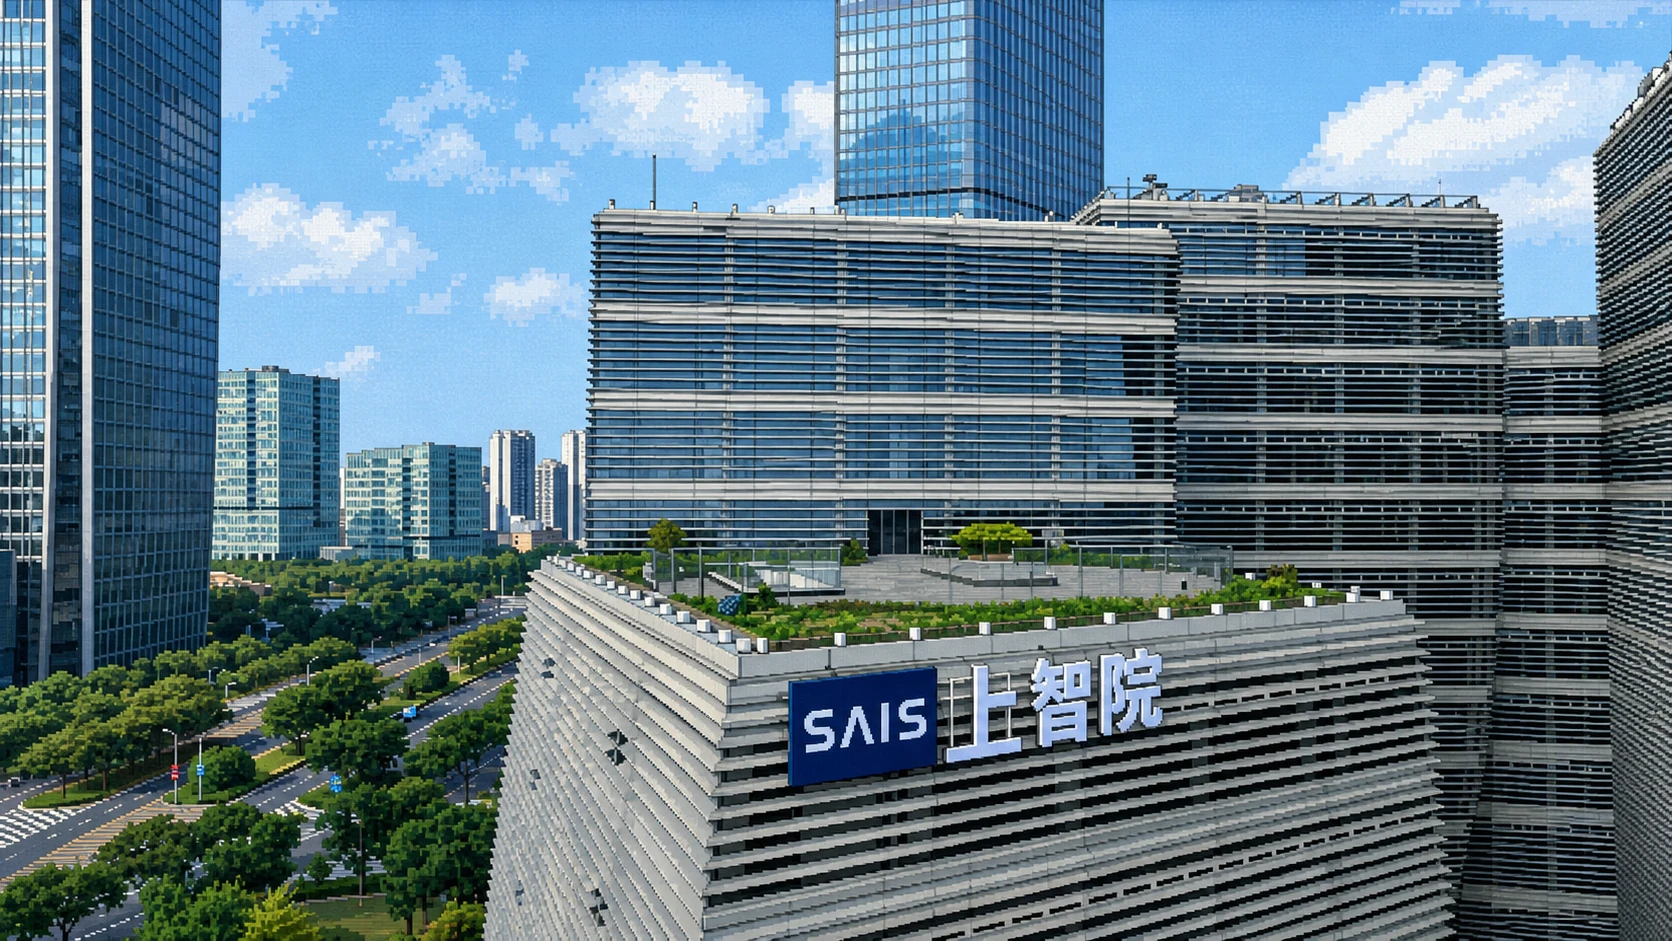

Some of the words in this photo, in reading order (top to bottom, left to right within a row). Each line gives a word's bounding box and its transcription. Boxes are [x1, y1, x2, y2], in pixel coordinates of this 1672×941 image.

[803, 697, 927, 754] SAIS
[945, 647, 1164, 764] 上智院
